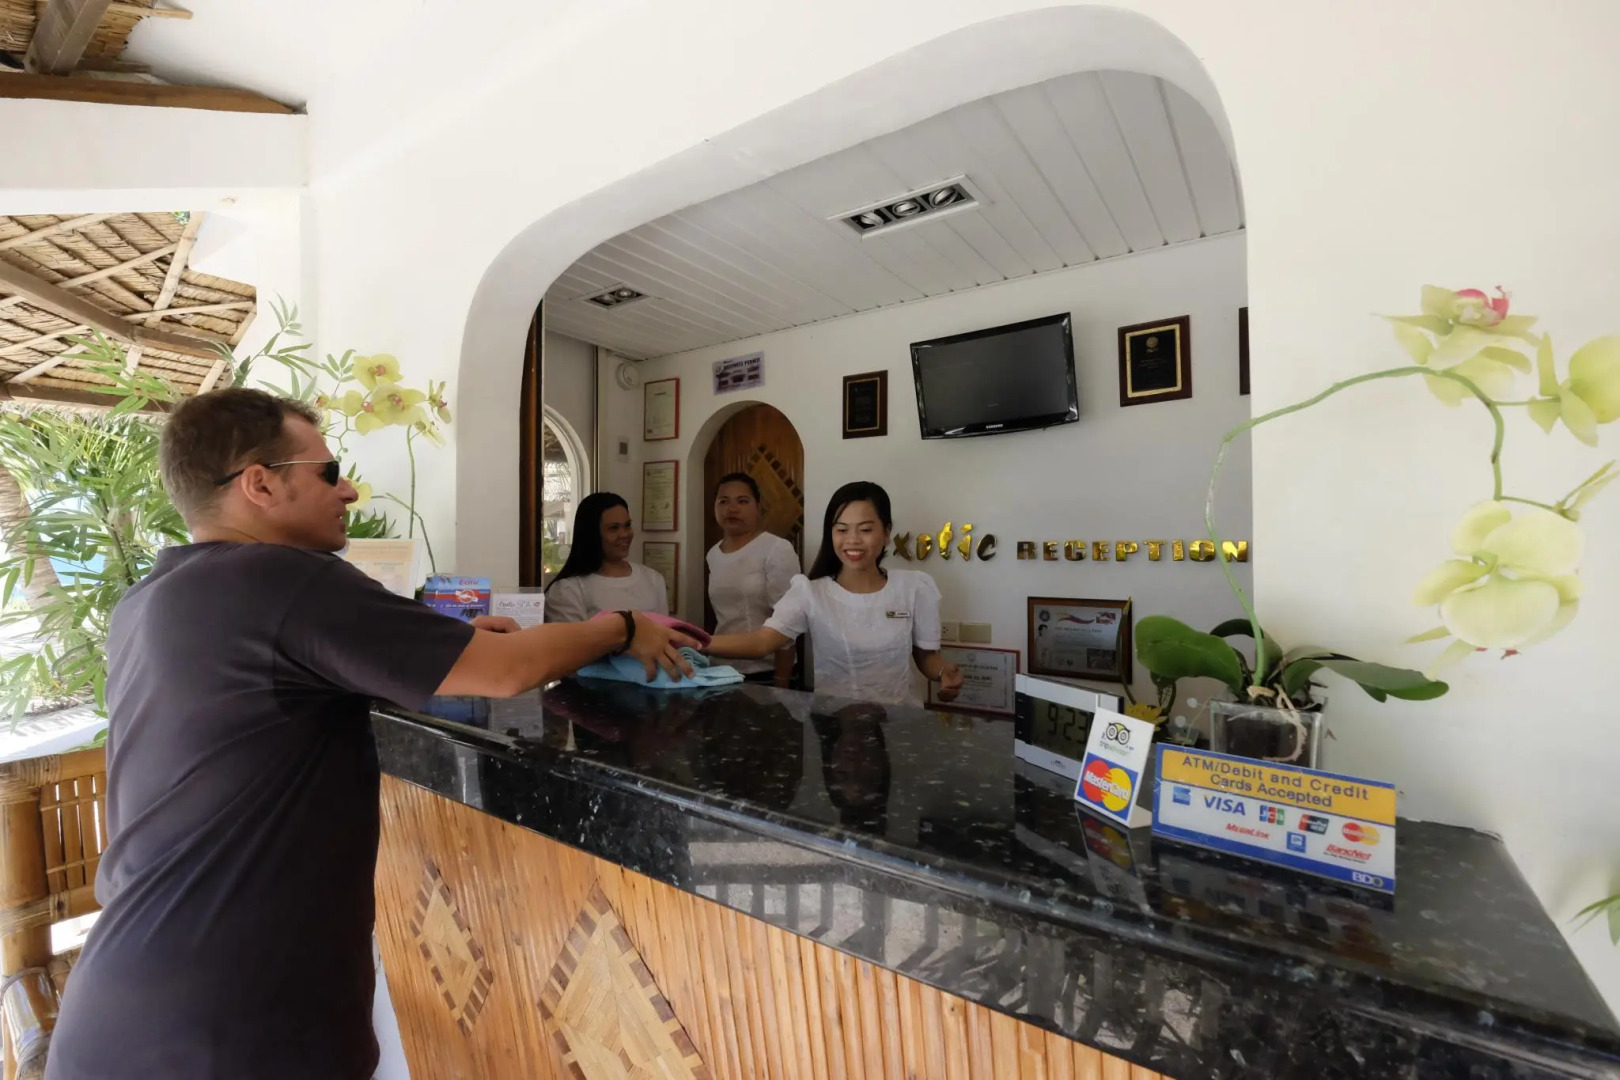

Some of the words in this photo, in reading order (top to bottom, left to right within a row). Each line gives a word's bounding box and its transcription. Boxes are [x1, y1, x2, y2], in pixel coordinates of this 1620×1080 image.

[893, 520, 997, 561] xotic
[1016, 540, 1249, 562] RECEPTION
[1084, 770, 1129, 801] MasterCard
[1182, 755, 1263, 780] ATM/Debit
[1271, 773, 1302, 788] and
[1310, 778, 1368, 800] Credit
[1210, 774, 1252, 791] Cards
[1257, 783, 1332, 807] Accepted
[1204, 796, 1246, 816] VISA
[1352, 871, 1384, 888] BDO
